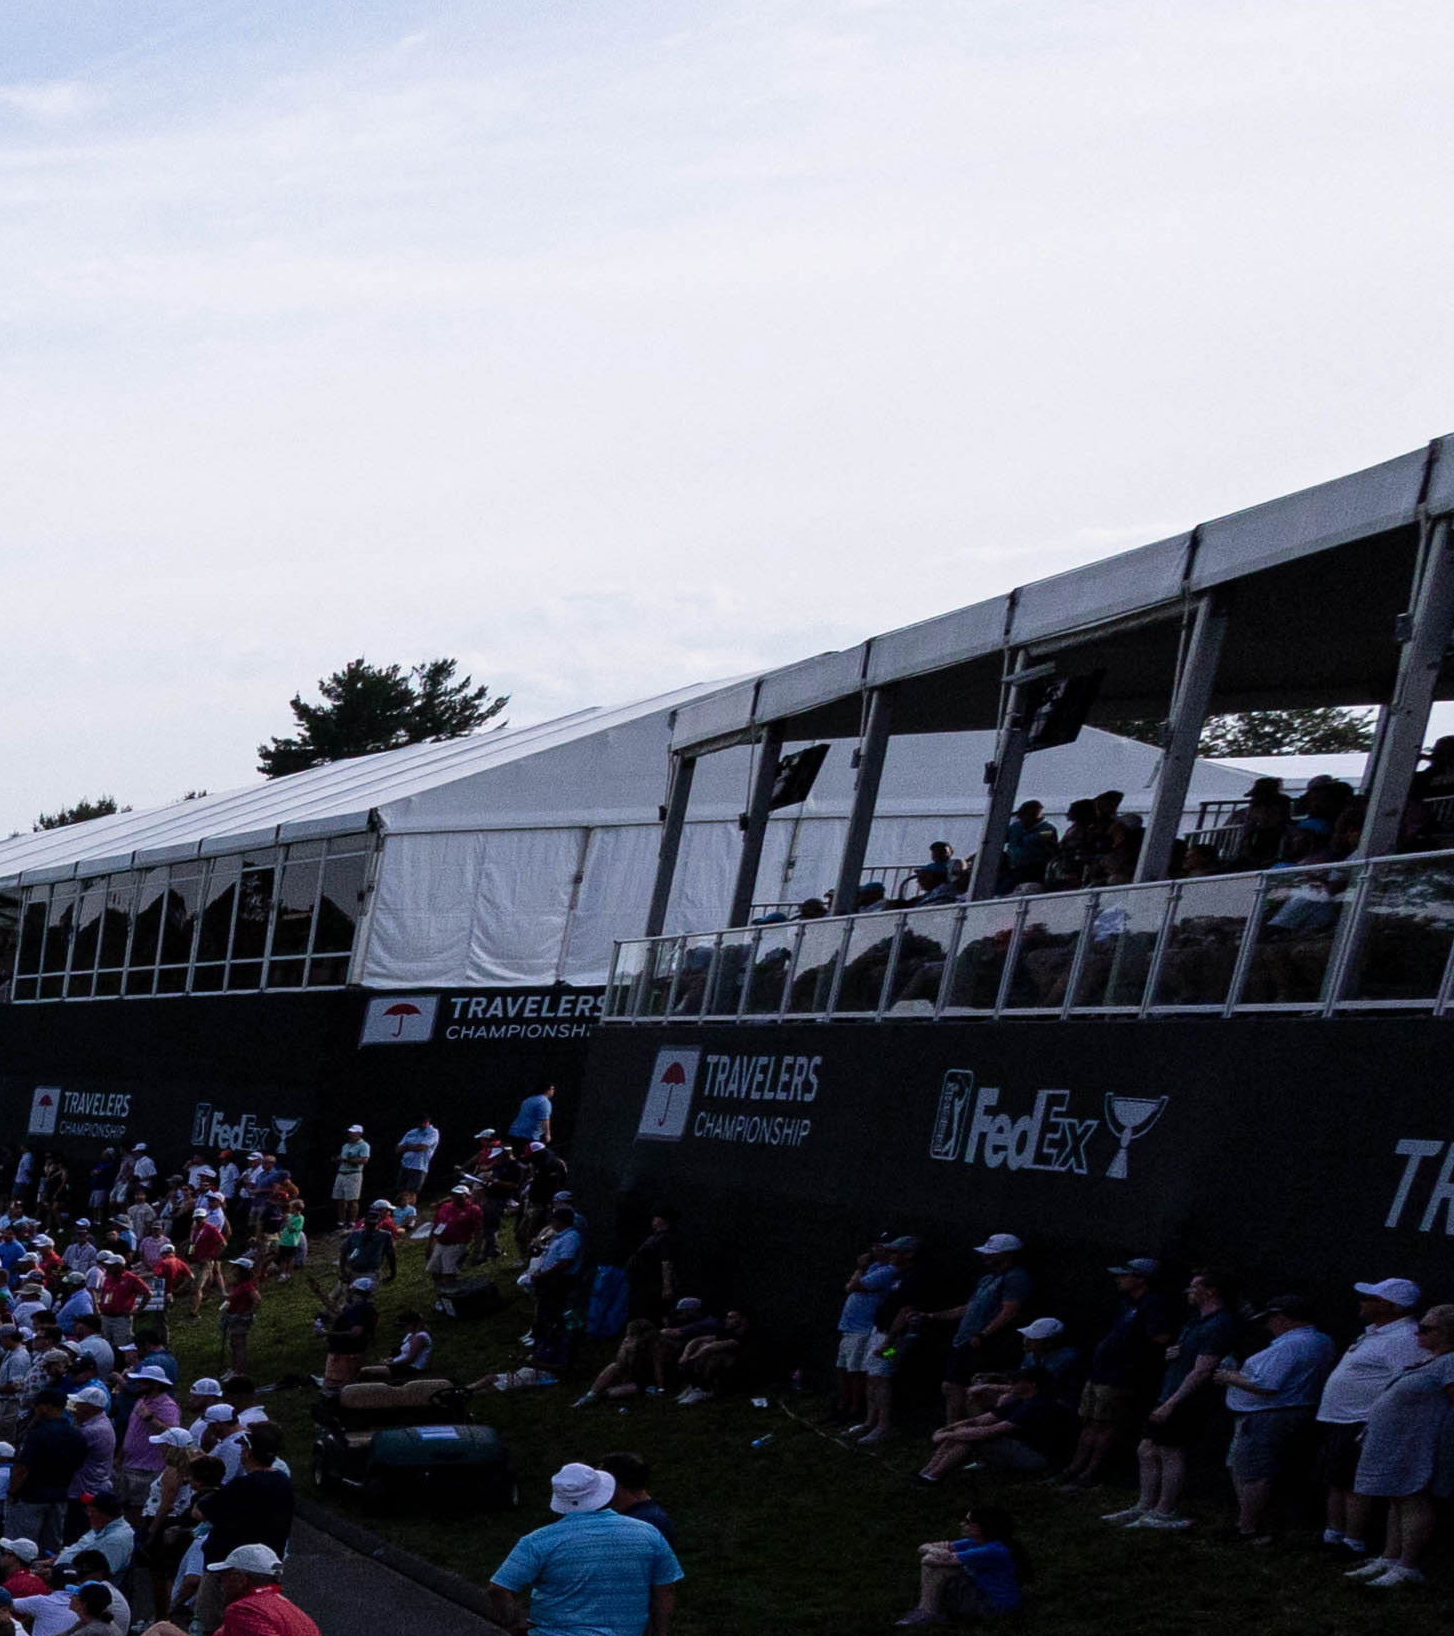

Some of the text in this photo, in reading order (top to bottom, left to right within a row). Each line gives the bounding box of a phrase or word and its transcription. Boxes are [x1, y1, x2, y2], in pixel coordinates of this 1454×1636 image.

[450, 995, 606, 1019] TRAVELERS
[446, 1023, 591, 1040] CHAMPIONSH
[704, 1055, 823, 1102] TRAVELERS
[63, 1091, 132, 1118] TRAVELERS
[59, 1120, 127, 1139] CHAMPIONSHIP
[208, 1111, 270, 1150] FedEx
[693, 1111, 812, 1147] CHAMPIONSHIP
[964, 1087, 1100, 1175] FedEx
